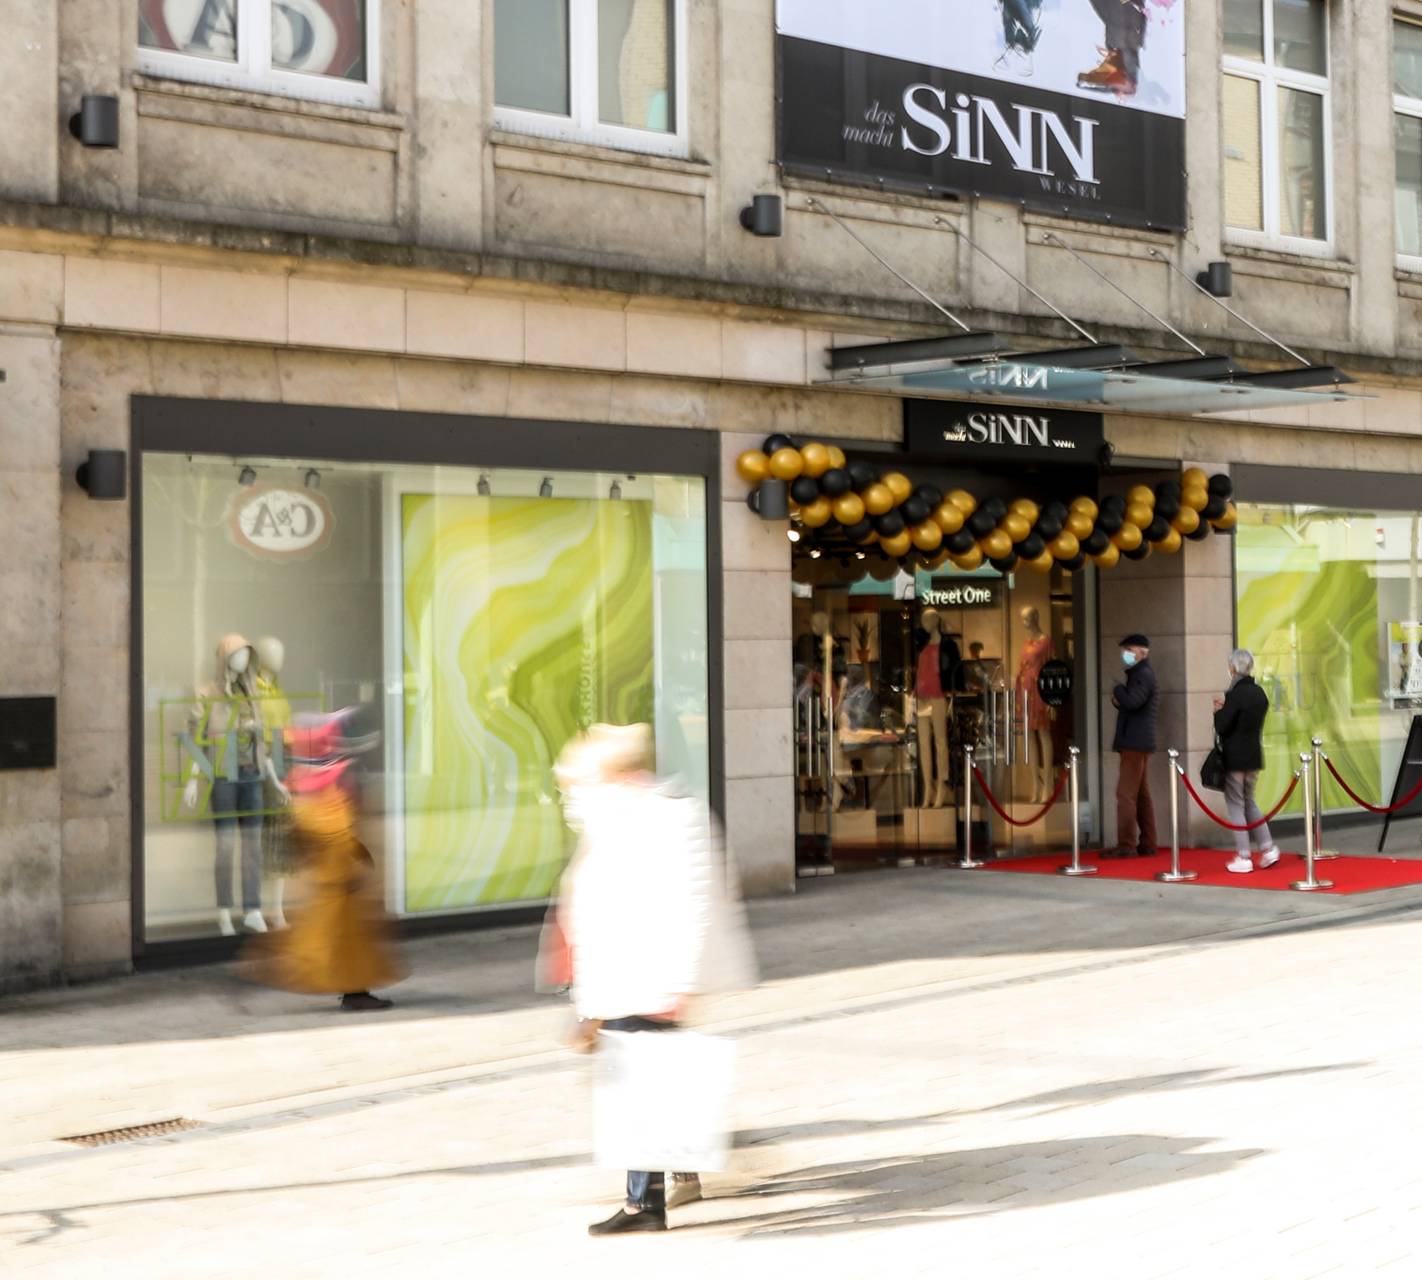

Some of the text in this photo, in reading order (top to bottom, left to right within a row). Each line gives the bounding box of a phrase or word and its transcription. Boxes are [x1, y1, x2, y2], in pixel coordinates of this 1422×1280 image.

[866, 101, 895, 125] das
[843, 127, 893, 146] macht
[902, 83, 1100, 184] SiNN
[1041, 178, 1100, 199] WESEL
[922, 586, 992, 605] Street One
